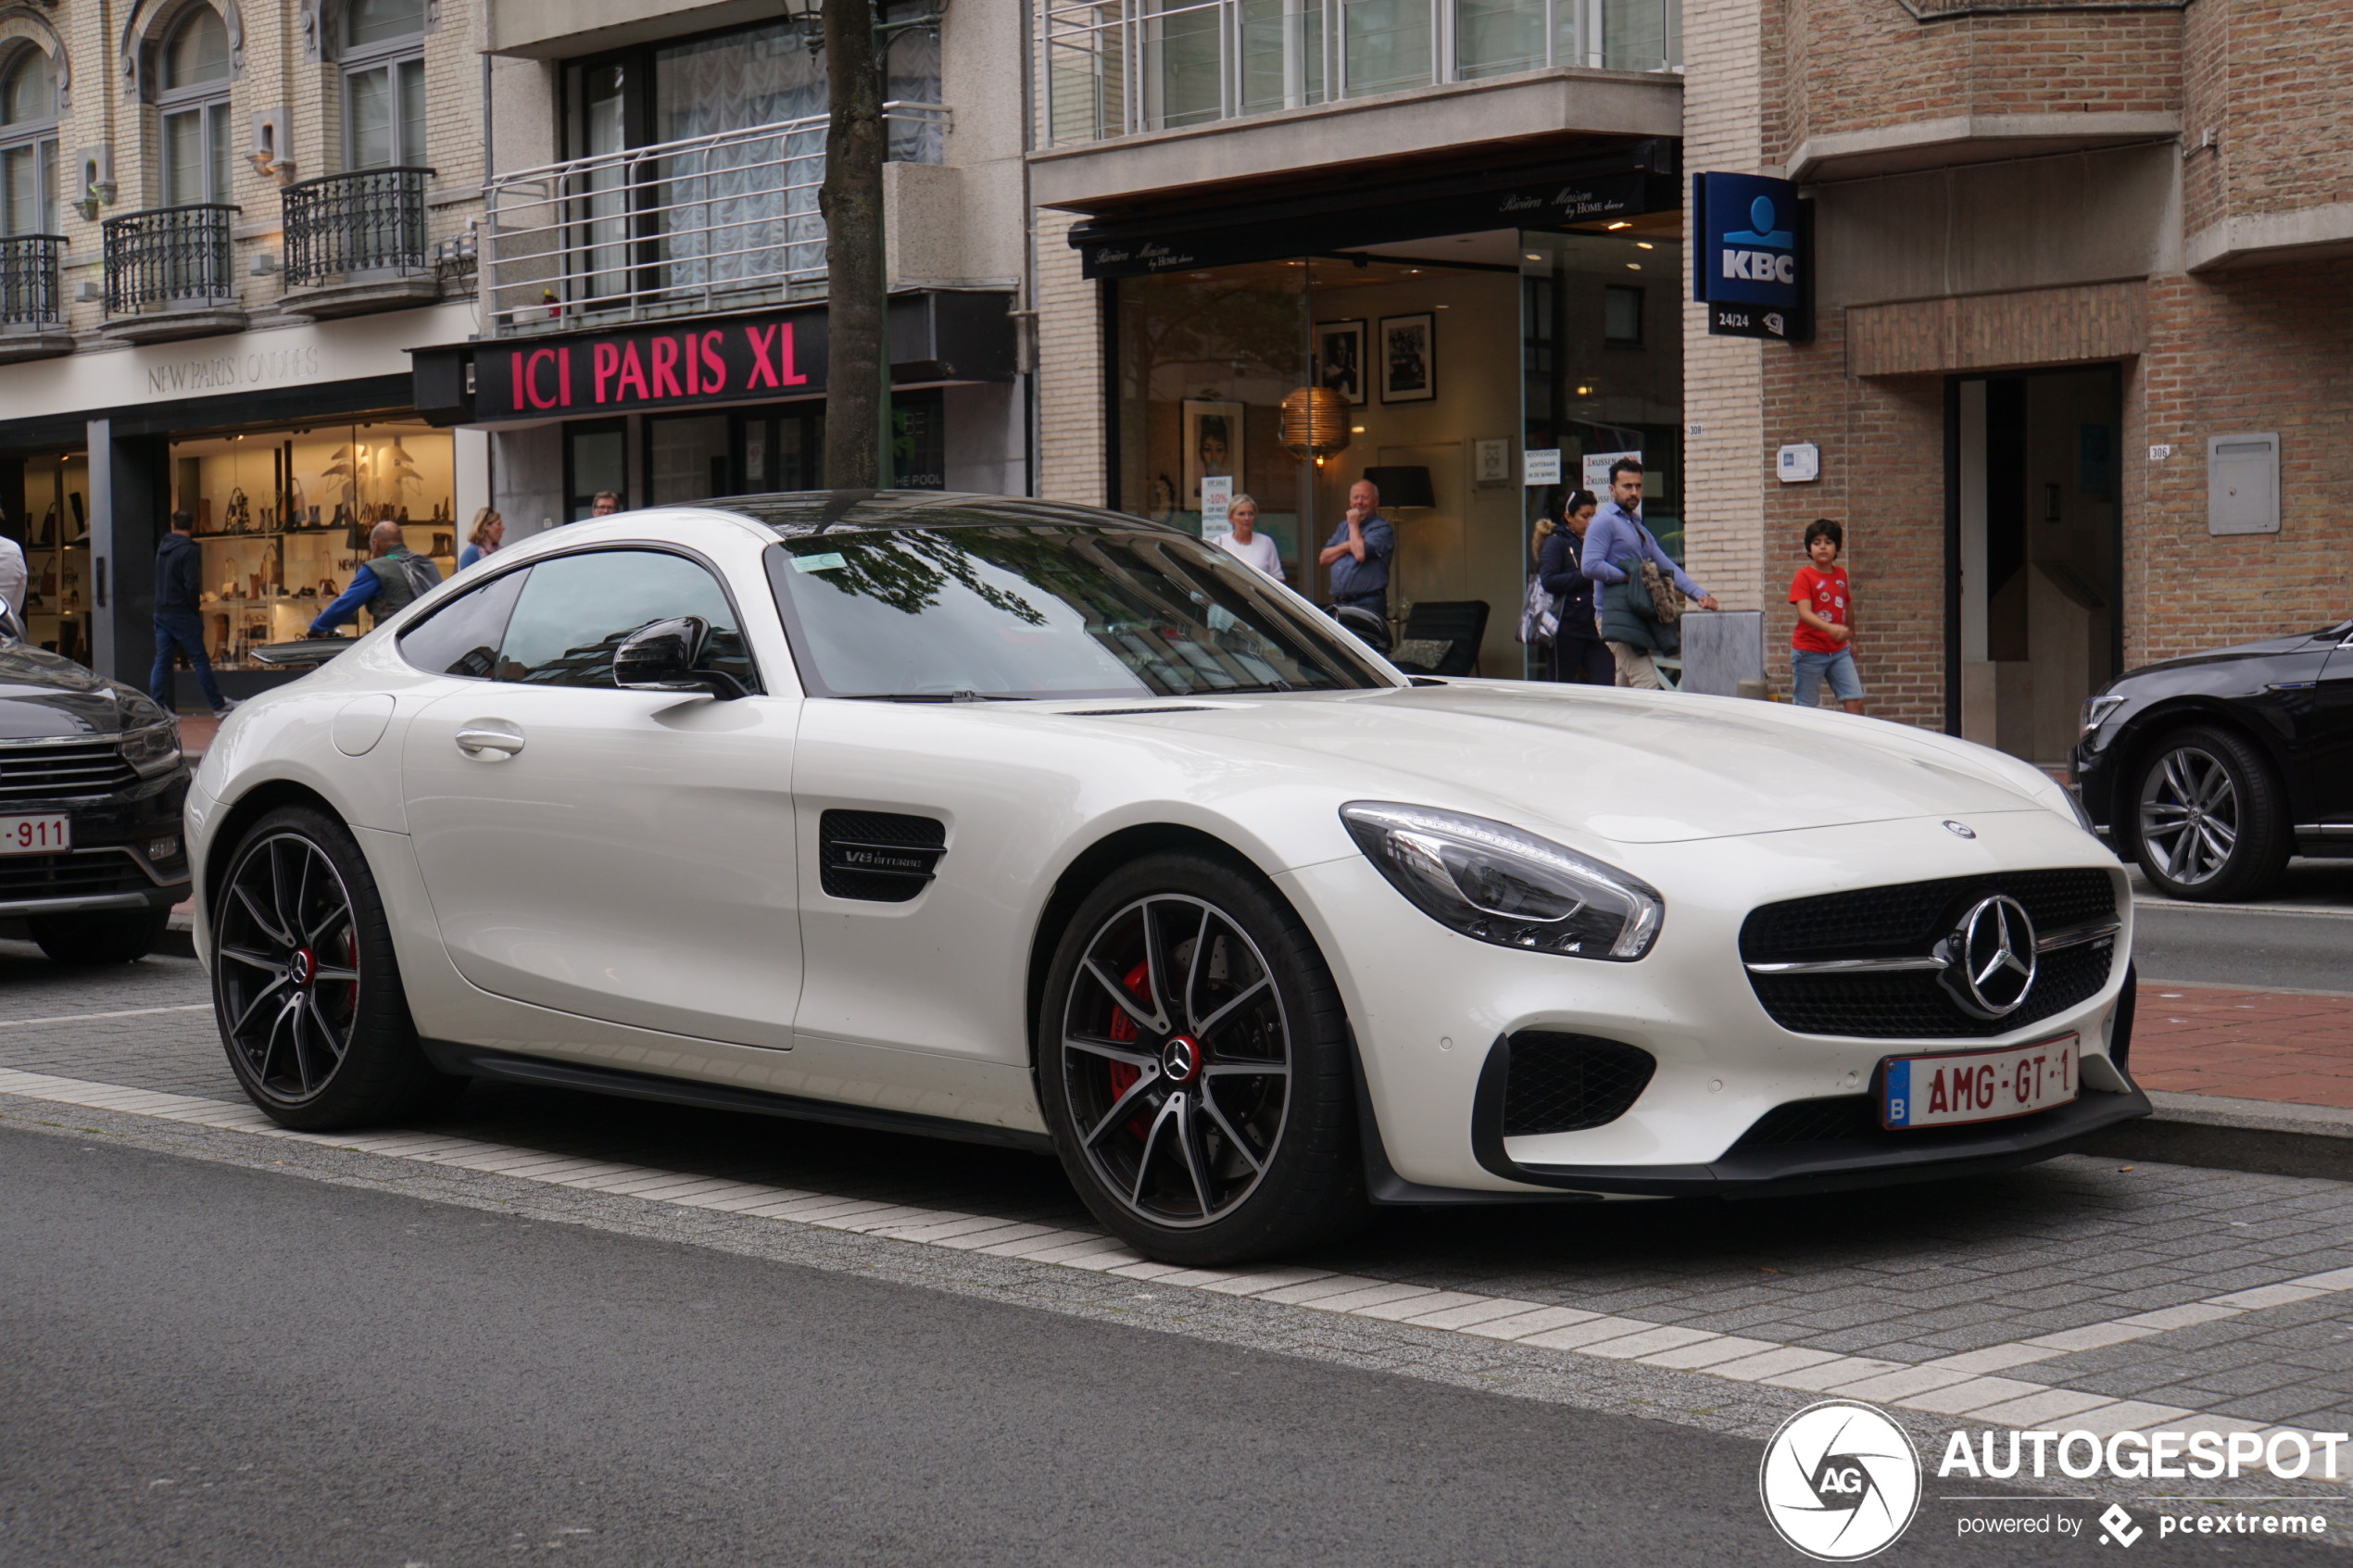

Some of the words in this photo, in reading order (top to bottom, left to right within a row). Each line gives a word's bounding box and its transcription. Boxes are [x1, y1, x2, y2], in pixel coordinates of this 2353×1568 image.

[1565, 205, 1575, 220] by
[1577, 202, 1603, 214] HOME
[1158, 256, 1177, 267] HOME
[1722, 249, 1793, 284] KBC
[1719, 312, 1749, 328] 24/24
[148, 363, 186, 395] NEW
[191, 358, 234, 390] PARIS
[238, 346, 319, 384] LONDRES
[511, 347, 571, 410] ICI
[594, 330, 726, 404] PARIS
[745, 322, 807, 390] XL
[1690, 425, 1702, 435] 308
[2152, 446, 2168, 458] 306
[912, 474, 942, 485] POOL
[1216, 478, 1227, 486] SALE
[1207, 493, 1227, 505] -10%
[338, 558, 355, 571] NEW
[845, 851, 873, 863] V8
[1928, 1048, 2069, 1114] AMG-GT-1
[1891, 1098, 1905, 1120] B
